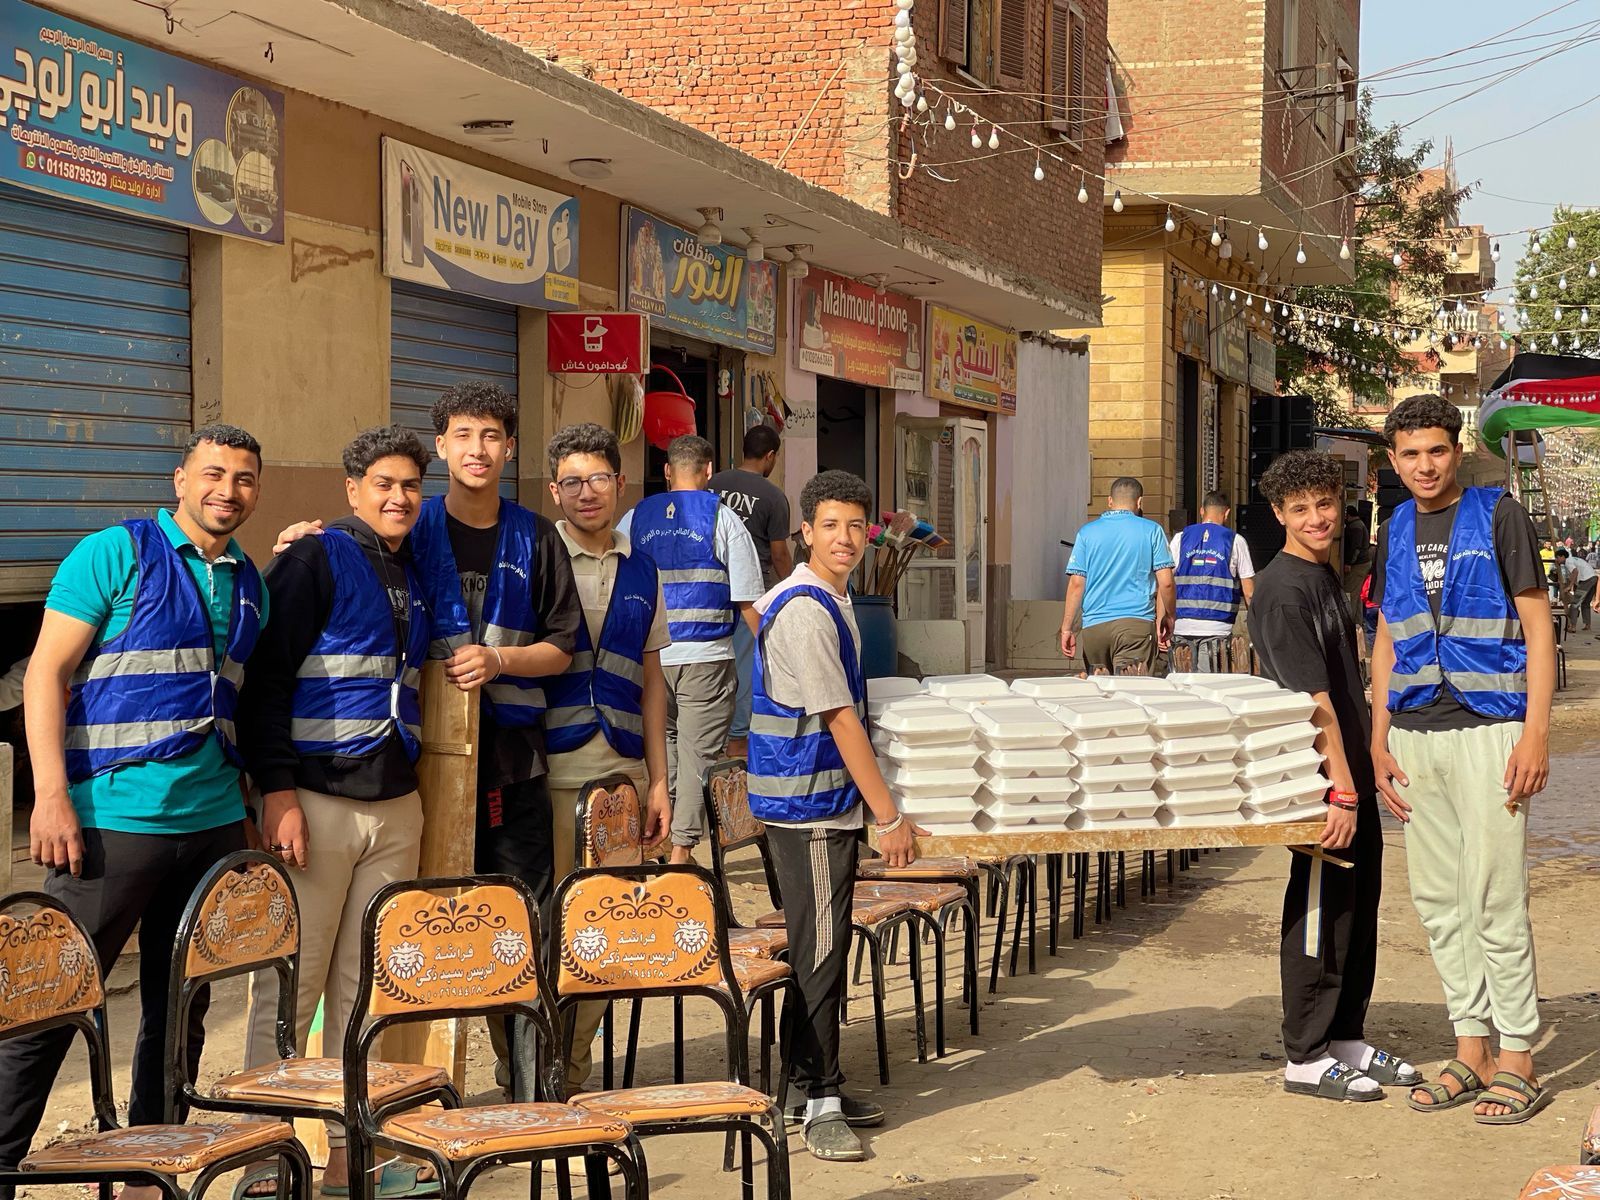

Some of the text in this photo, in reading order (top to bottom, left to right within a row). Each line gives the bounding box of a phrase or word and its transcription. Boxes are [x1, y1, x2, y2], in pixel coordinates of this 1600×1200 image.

[40, 27, 113, 65] بسم الله الرحمن الرحيم
[79, 51, 124, 136] أبو
[131, 83, 193, 157] وليد
[46, 158, 107, 187] 01158795329
[512, 192, 548, 215] Mobile Store
[433, 175, 540, 267] New Day
[673, 237, 715, 266] منظفات
[671, 255, 744, 308] النور
[823, 279, 908, 336] Mahmoud phone
[561, 359, 586, 371] كاش
[953, 325, 999, 384] الشيخ
[1427, 543, 1448, 554] CARE
[616, 928, 656, 946] فراشة
[434, 943, 474, 962] فراشة
[622, 953, 646, 967] سيد
[648, 949, 678, 967] الريس
[439, 968, 464, 984] سيد
[466, 960, 496, 982] الريس
